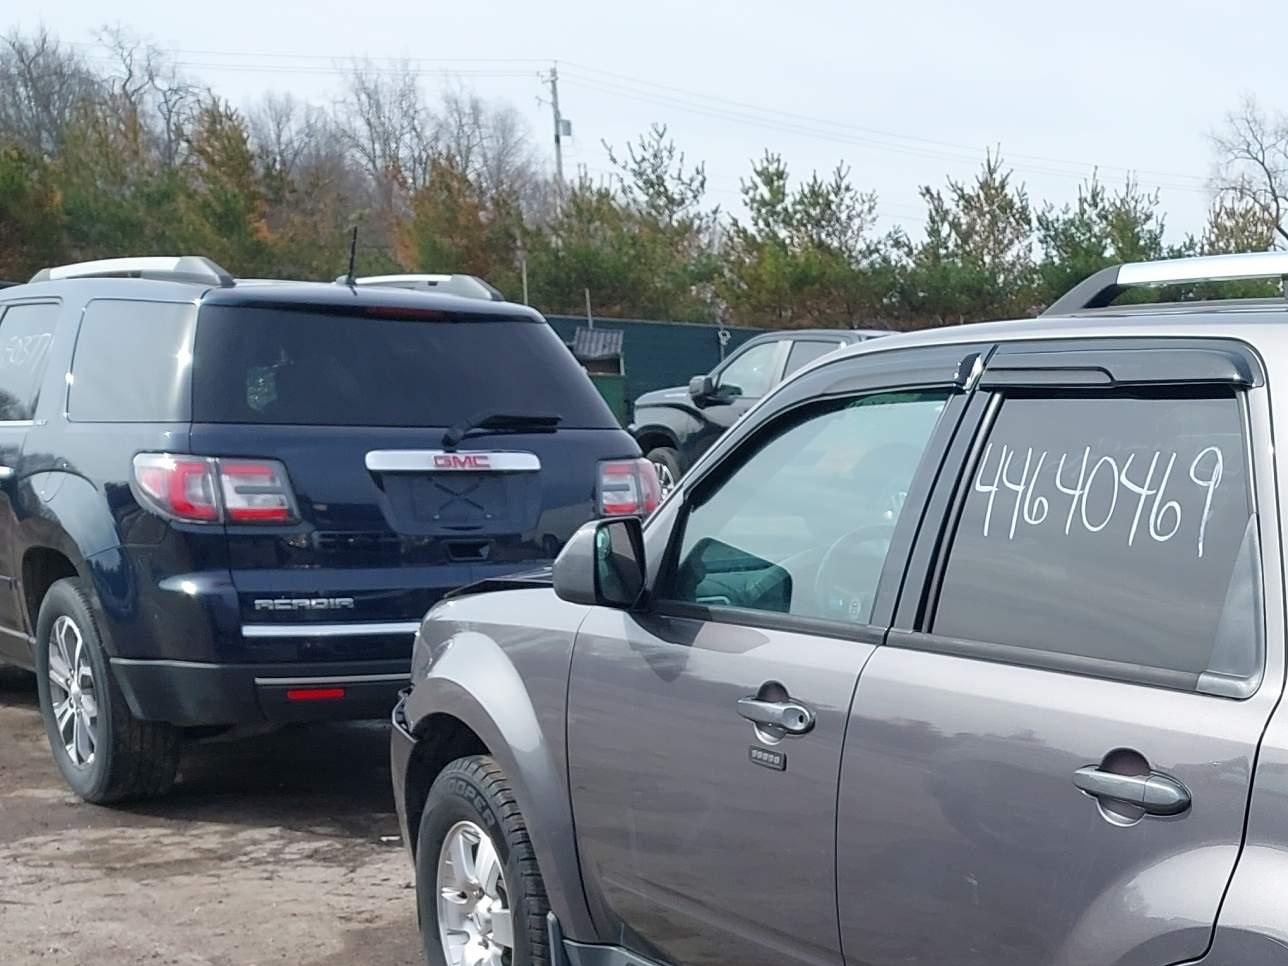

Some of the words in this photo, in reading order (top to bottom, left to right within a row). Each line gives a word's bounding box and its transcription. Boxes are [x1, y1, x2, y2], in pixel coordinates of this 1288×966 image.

[432, 455, 491, 468] GMC
[975, 443, 1223, 558] 44640469
[254, 598, 354, 610] ACADIA
